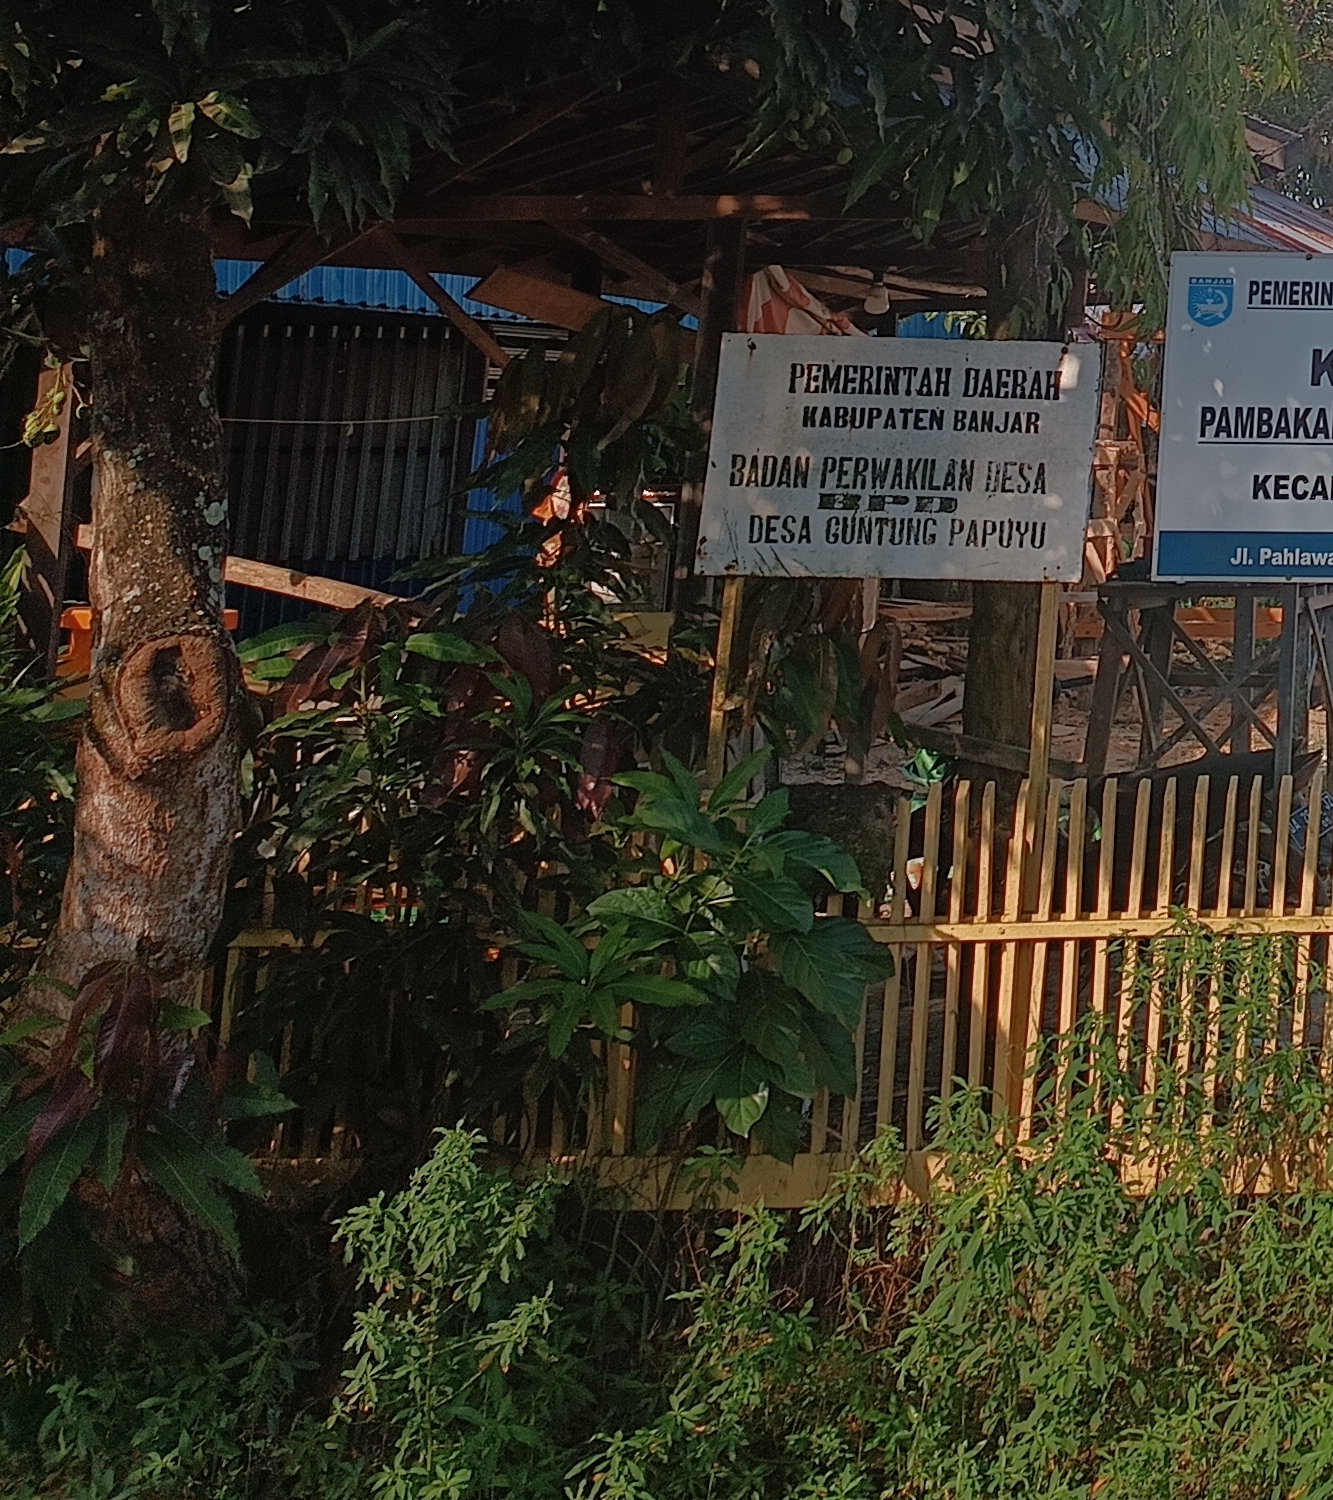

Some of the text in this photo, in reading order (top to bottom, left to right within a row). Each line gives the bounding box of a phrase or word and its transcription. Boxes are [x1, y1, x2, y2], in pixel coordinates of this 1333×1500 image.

[788, 363, 1062, 400] PEMERINTAH DAERAH
[802, 406, 1041, 434] KABUPATEN BANJAR
[729, 454, 1047, 495] BADAN PERWAKILAN DESA
[748, 515, 1047, 549] DESA GUNTUNG PAPUYU
[1230, 548, 1254, 566] Jl.
